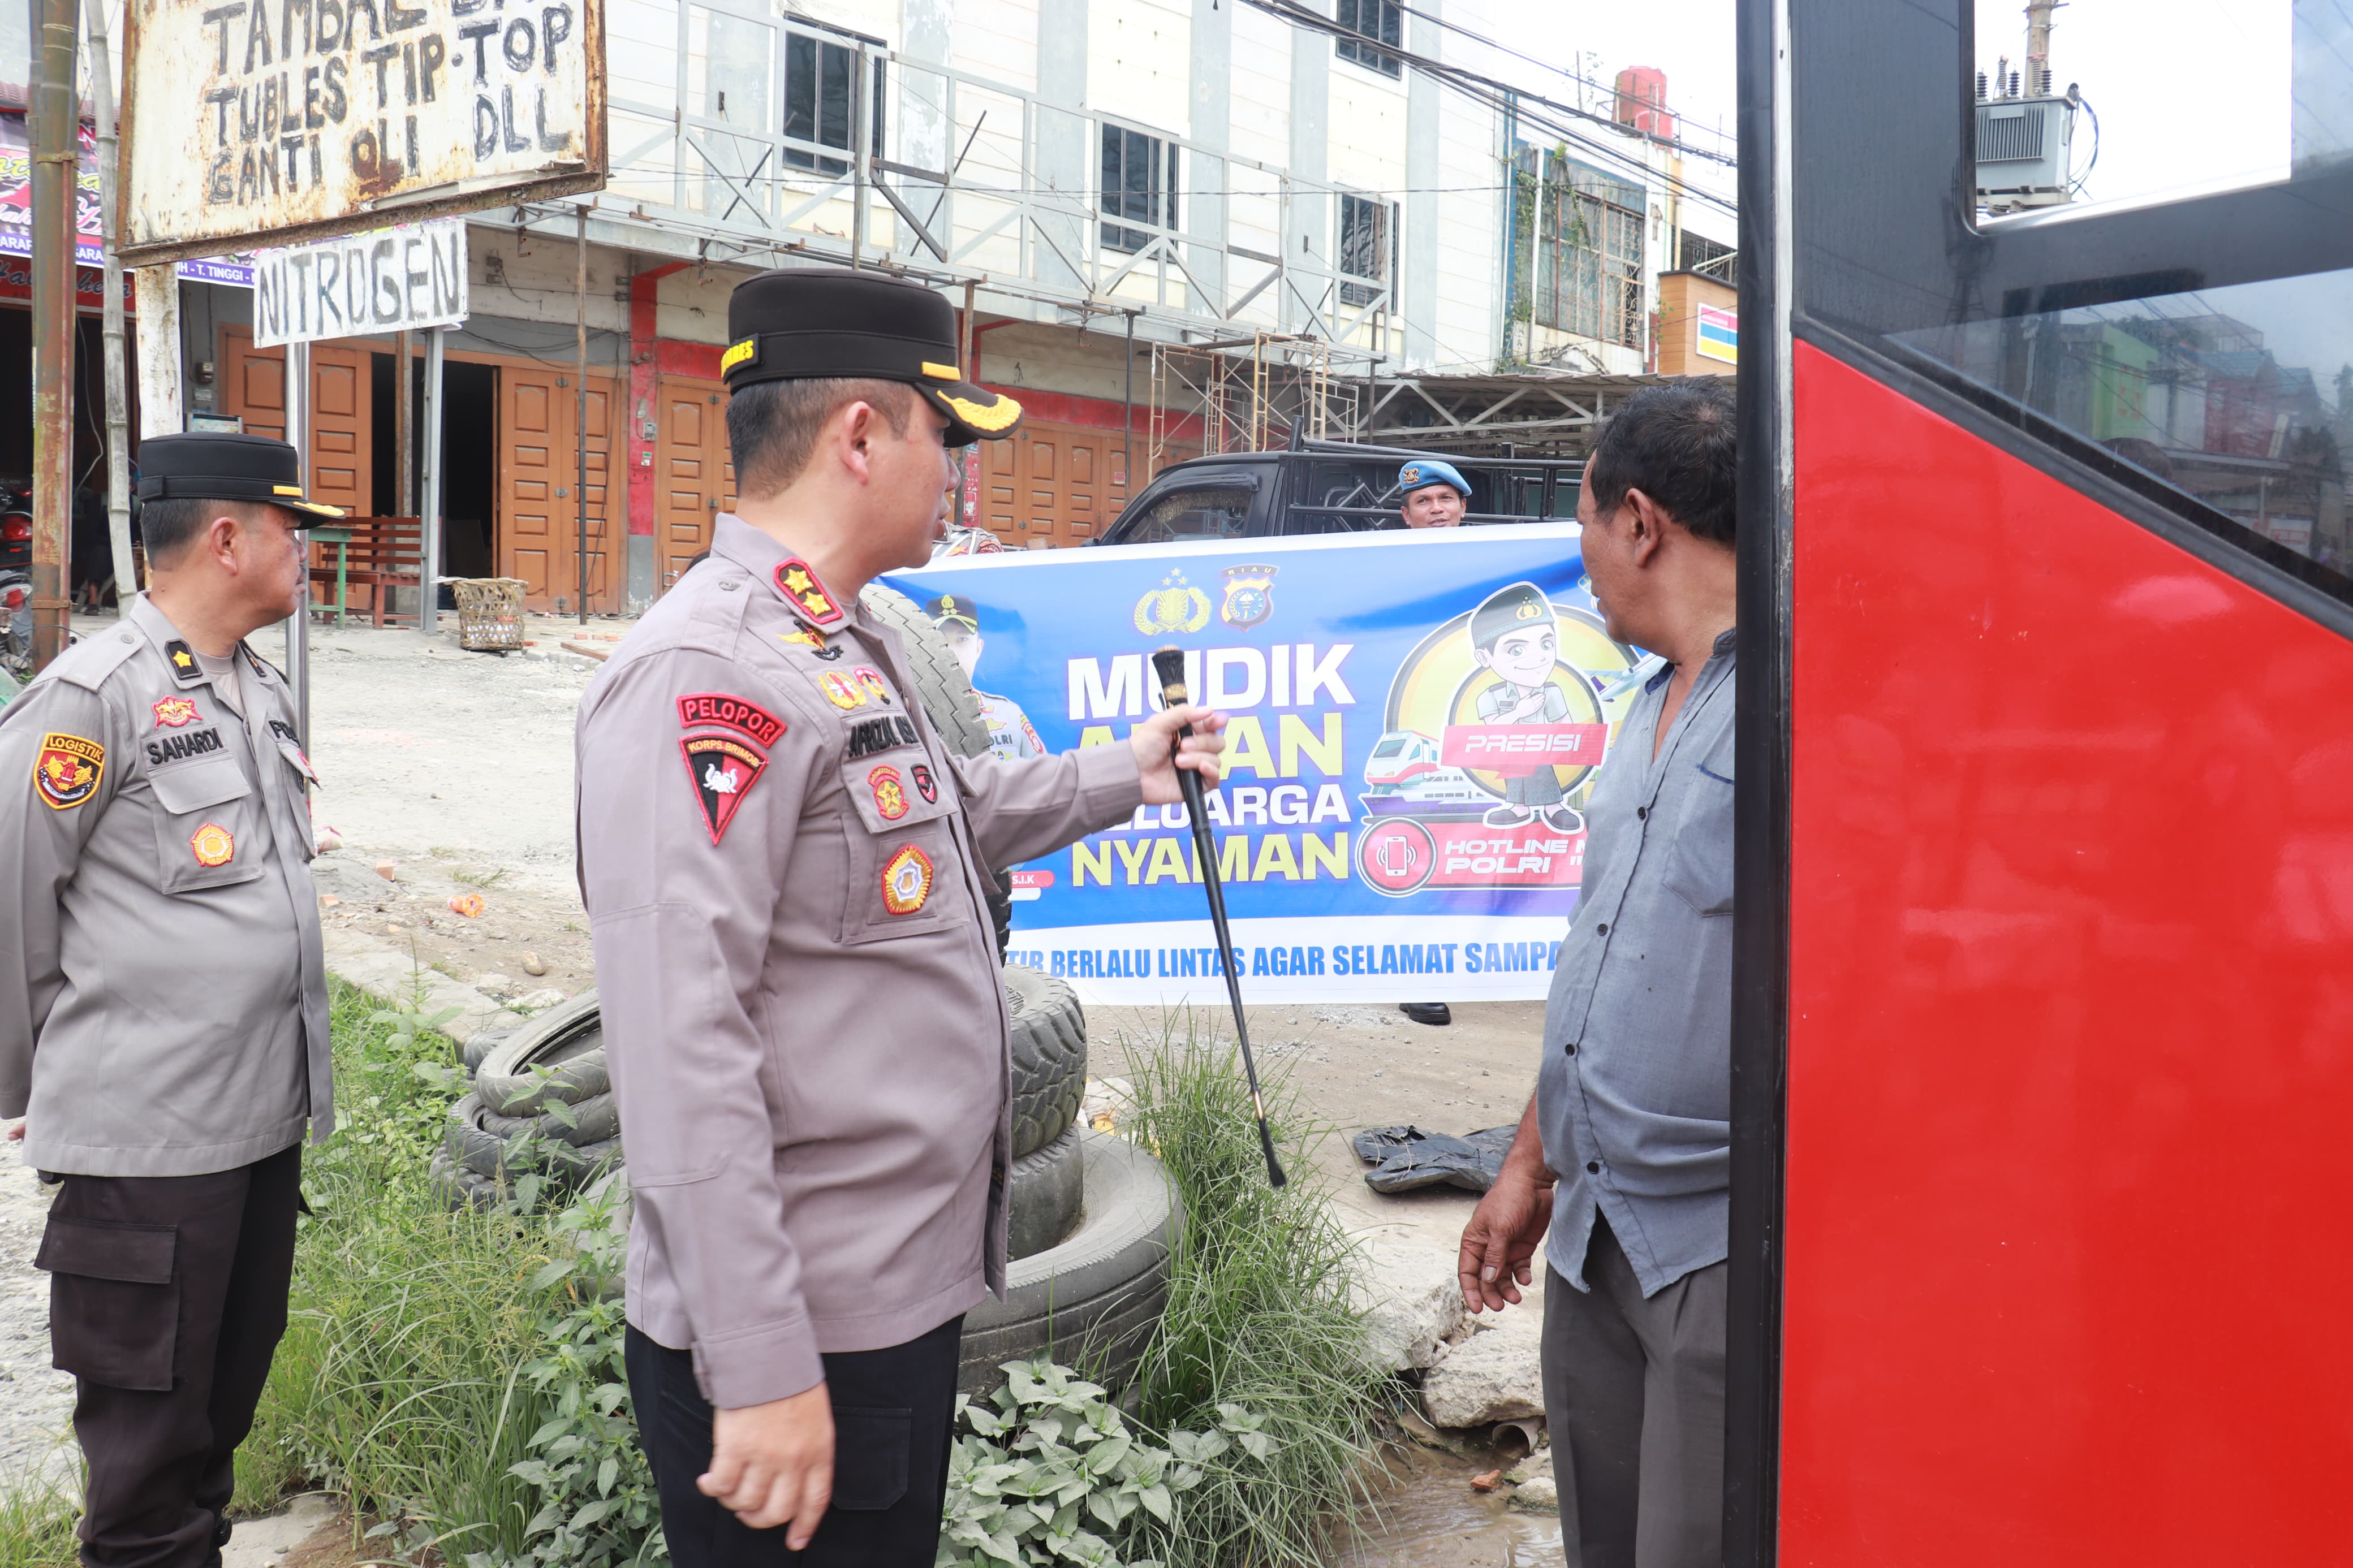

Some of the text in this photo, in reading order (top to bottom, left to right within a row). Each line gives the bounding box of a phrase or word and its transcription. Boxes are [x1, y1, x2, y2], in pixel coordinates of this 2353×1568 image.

[204, 55, 348, 147] TUBLES
[208, 133, 323, 205] GANTI
[473, 83, 571, 163] DLL
[207, 265, 243, 281] TINGGI
[258, 228, 460, 338] NITROGEN
[1227, 567, 1272, 575] RIAU
[1067, 643, 1356, 721] MUDIK
[685, 698, 776, 740] PELOPOR
[49, 737, 104, 761] LOGISTIK
[146, 727, 224, 764] SAHARDI
[688, 740, 760, 767] KORPS BRIMOB
[1464, 734, 1581, 753] PRESISI
[1071, 832, 1349, 887] NYAMAN
[1445, 839, 1570, 854] HOTLINE
[1445, 857, 1552, 874] POLRI
[1050, 949, 1150, 978] BERLALU
[1158, 947, 1246, 978] LINTAS
[1252, 946, 1325, 977] AGAR
[1333, 943, 1458, 976] SELAMAT
